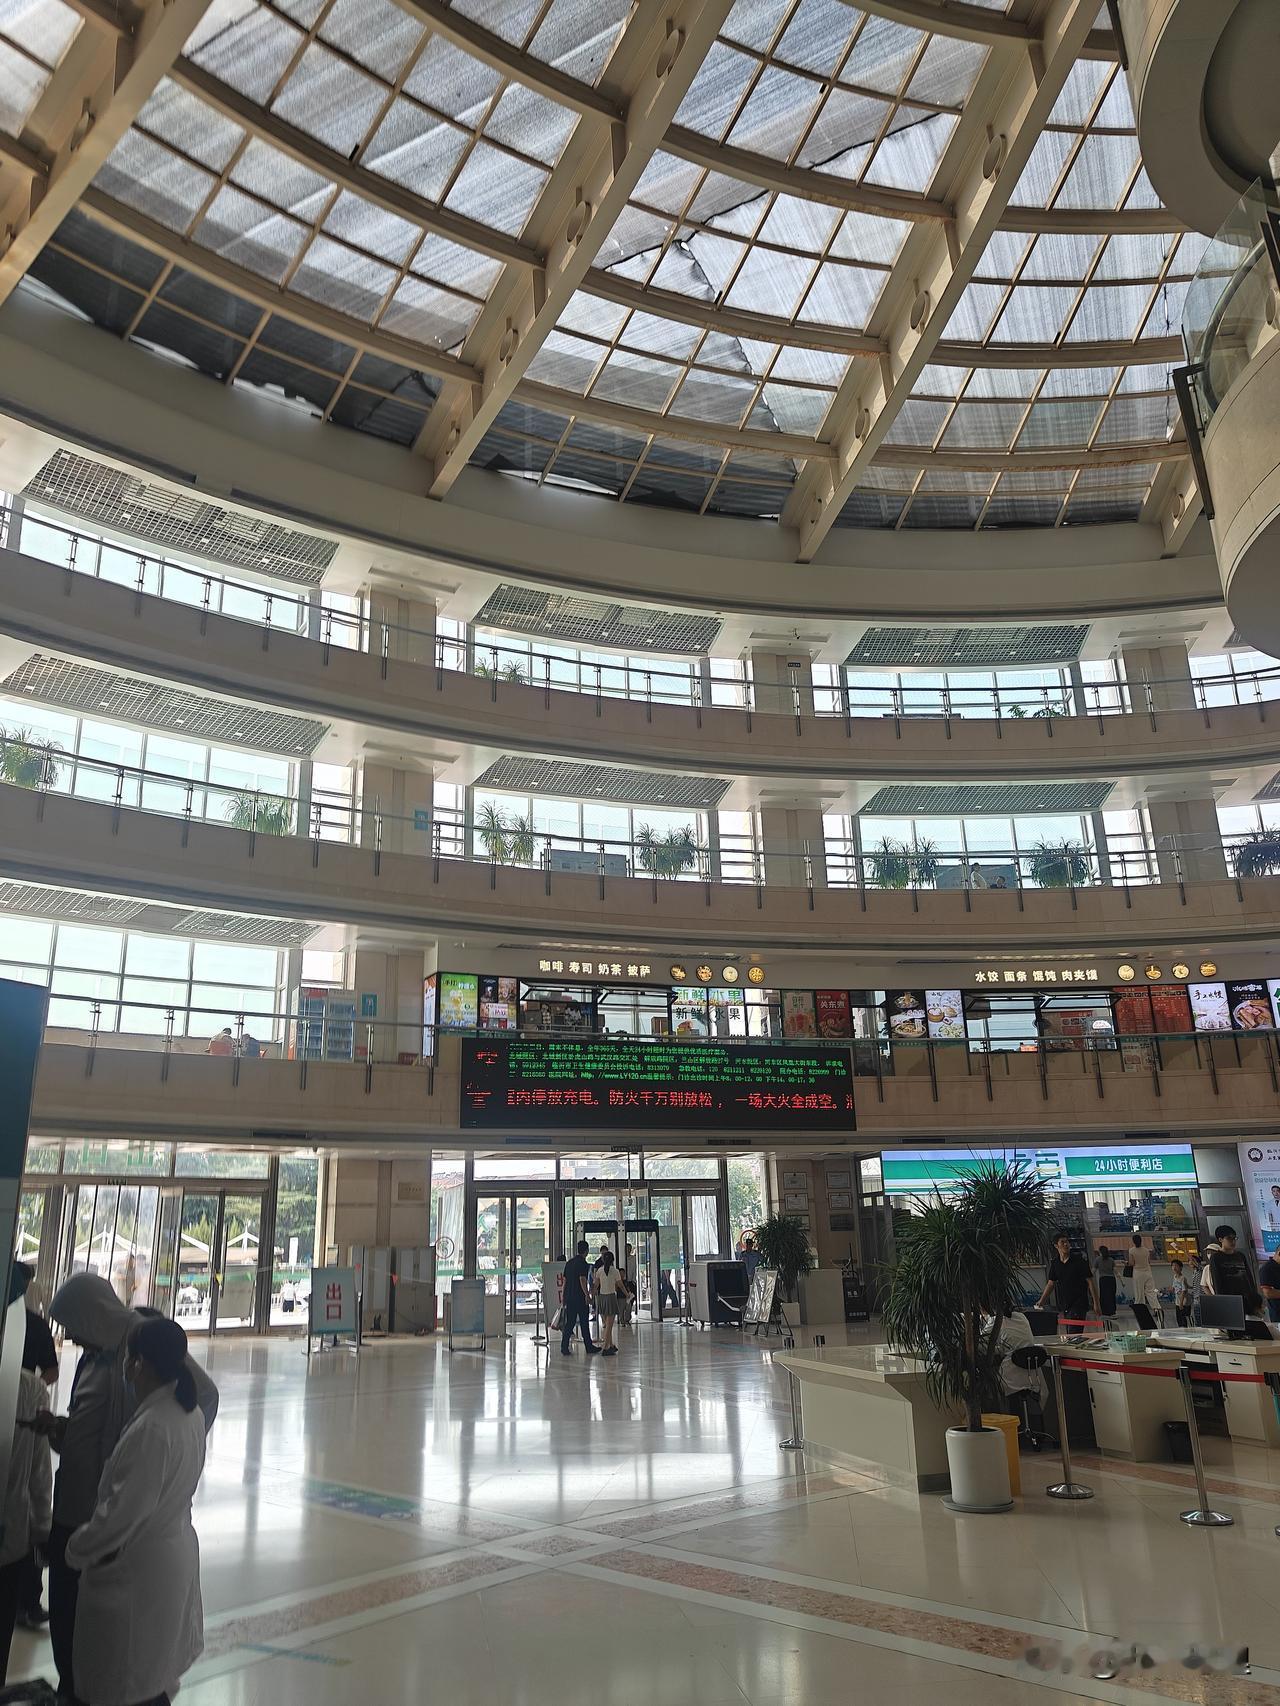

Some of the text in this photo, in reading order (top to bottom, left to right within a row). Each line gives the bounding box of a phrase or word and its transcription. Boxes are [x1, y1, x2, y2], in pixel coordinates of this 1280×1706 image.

[539, 960, 651, 977] 咖啡 寿司 奶茶 披萨
[975, 969, 1098, 982] 水饺 面条 馄饨 肉夹馍
[1094, 1158, 1163, 1172] 24小时便利店
[326, 1282, 342, 1321] 出口
